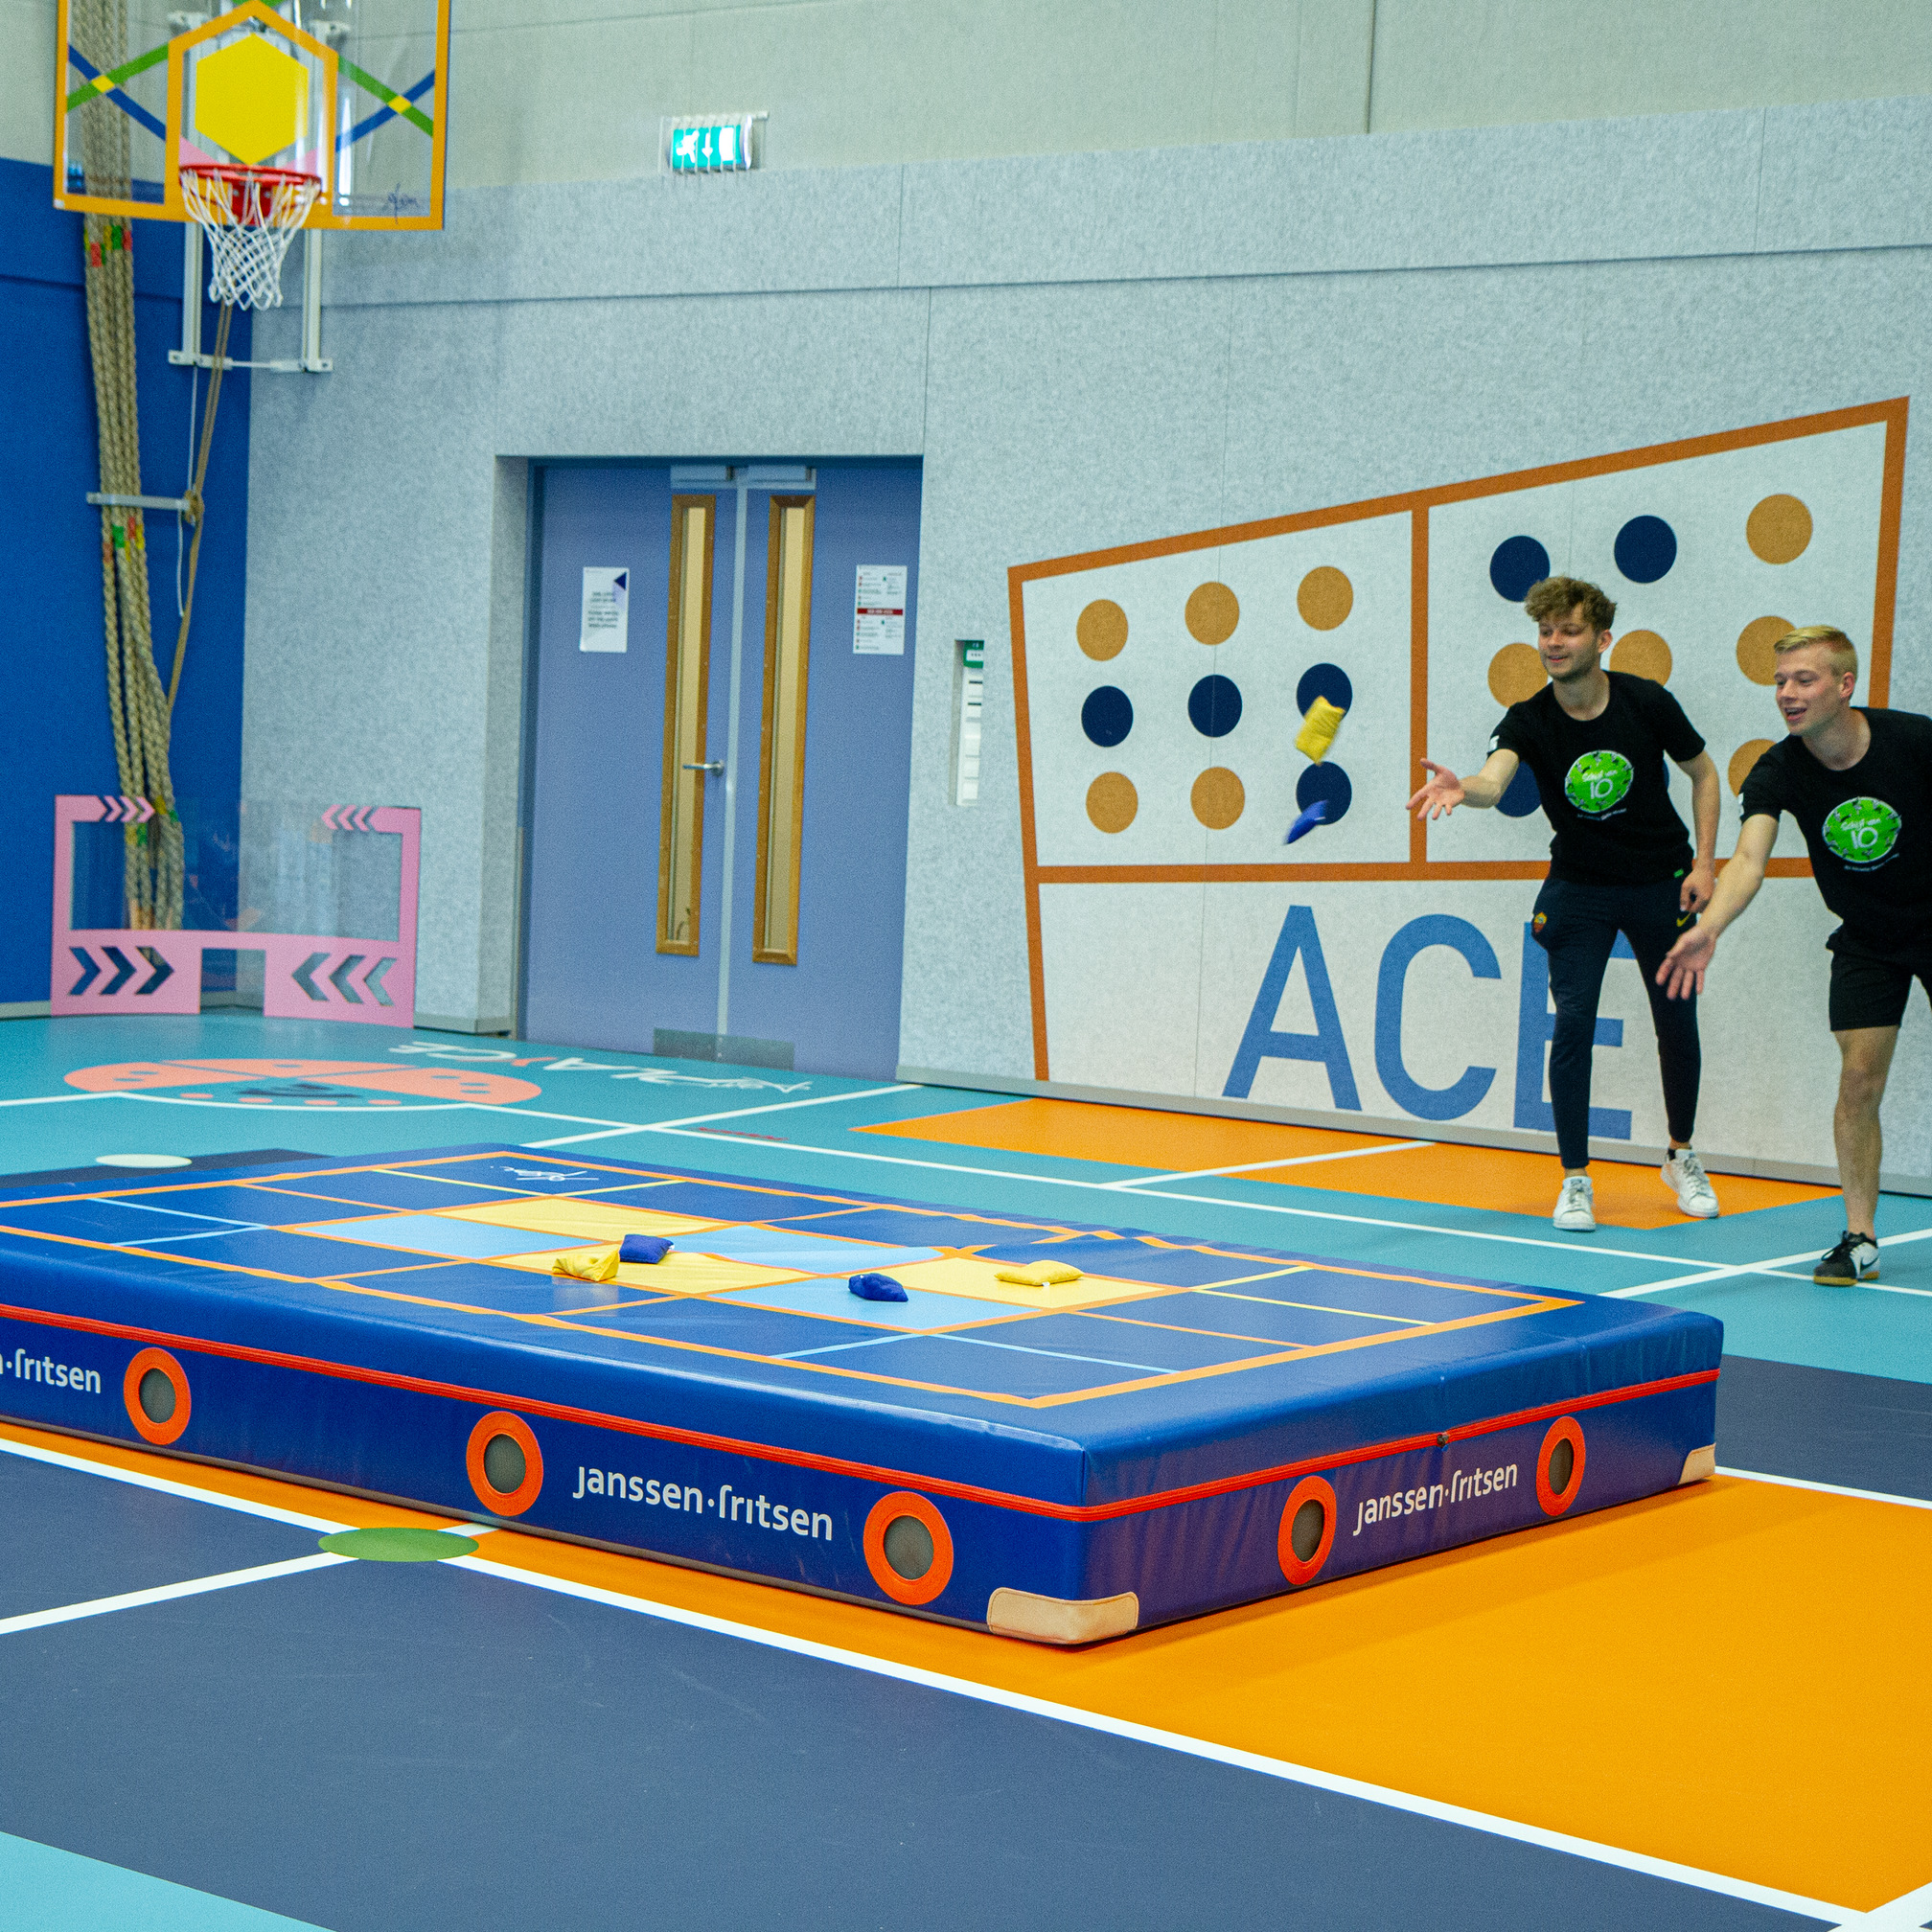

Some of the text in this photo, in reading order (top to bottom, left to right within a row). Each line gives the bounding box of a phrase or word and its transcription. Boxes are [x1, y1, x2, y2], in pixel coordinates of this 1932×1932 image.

[1590, 777, 1613, 799] 10
[1851, 826, 1878, 850] 10
[1222, 905, 1635, 1140] ACE
